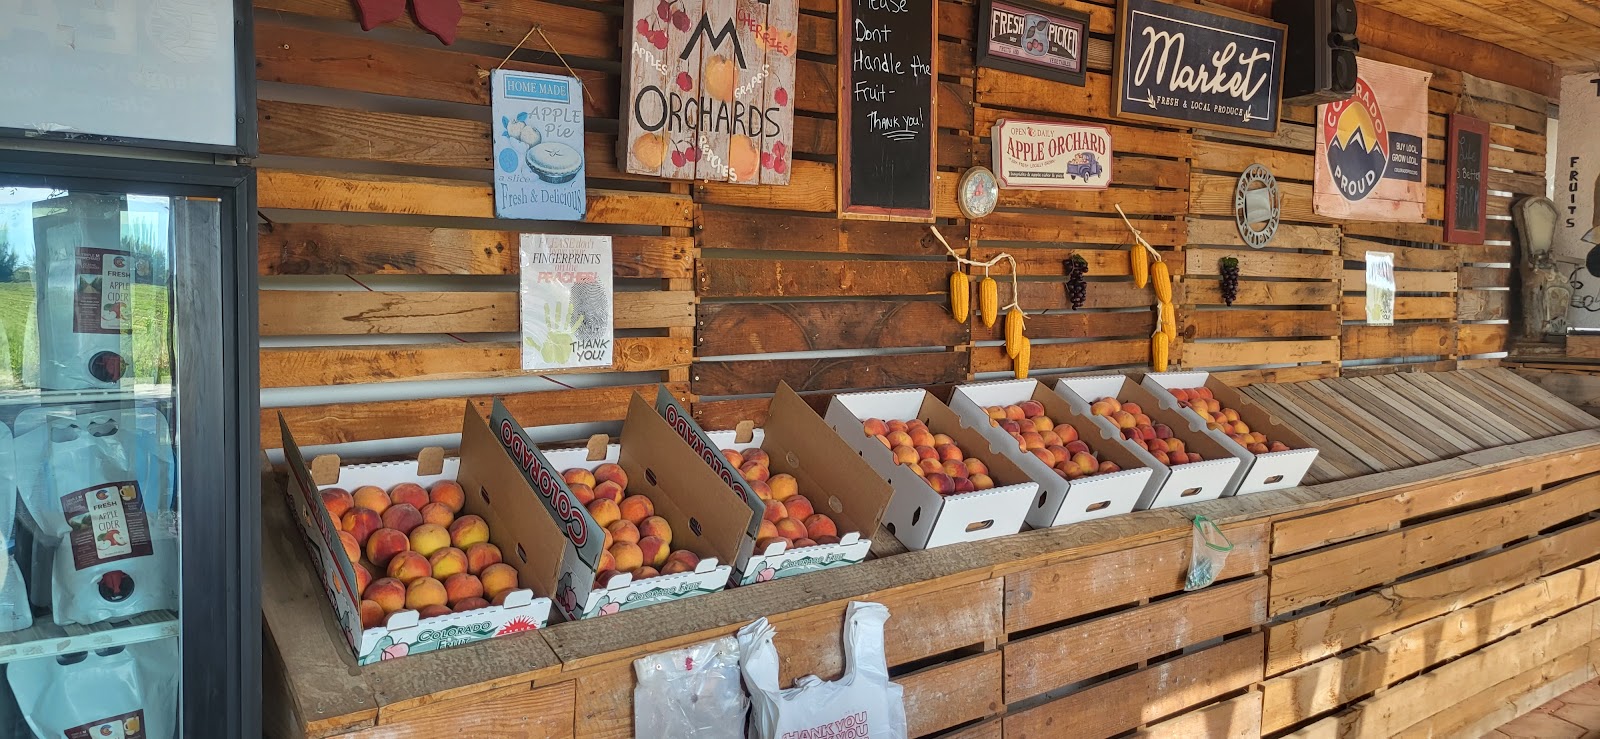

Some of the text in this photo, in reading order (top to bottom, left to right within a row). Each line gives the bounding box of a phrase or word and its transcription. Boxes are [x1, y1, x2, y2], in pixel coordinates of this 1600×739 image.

[679, 12, 747, 70] M
[738, 9, 789, 56] CHERRIES
[855, 18, 892, 43] Dont
[992, 10, 1078, 59] FRESH PICKED
[631, 42, 668, 76] APPLES
[853, 50, 932, 77] Handle the
[1134, 26, 1271, 102] Market
[507, 80, 567, 96] HOME MADE
[734, 64, 771, 100] GRAPES
[528, 106, 582, 124] APPLE
[634, 85, 781, 137] ORCHARDS
[1156, 95, 1244, 117] FRESH & LOCAL PRODUCE
[1328, 82, 1383, 134] CORADO
[545, 124, 575, 138] Pie
[1010, 127, 1055, 138] OPEN DAILY
[1007, 131, 1106, 162] APPLE ORCHARD
[1396, 142, 1405, 152] BUY
[1392, 153, 1406, 164] GROW
[1334, 164, 1376, 196] PROUD
[501, 183, 582, 213] Fresh & Delicious
[1566, 156, 1580, 228] FRUITS
[533, 253, 601, 264] FINGERPRINTS
[108, 292, 129, 302] CIDER
[109, 282, 129, 290] APPLE
[570, 339, 610, 352] THANK
[577, 350, 605, 362] YOU!
[500, 419, 588, 548] COLORADO
[93, 501, 117, 511] FRESH
[99, 510, 118, 521] APPLE
[99, 520, 120, 531] CIDER
[417, 620, 492, 643] COLORADO
[835, 711, 867, 731] YOU
